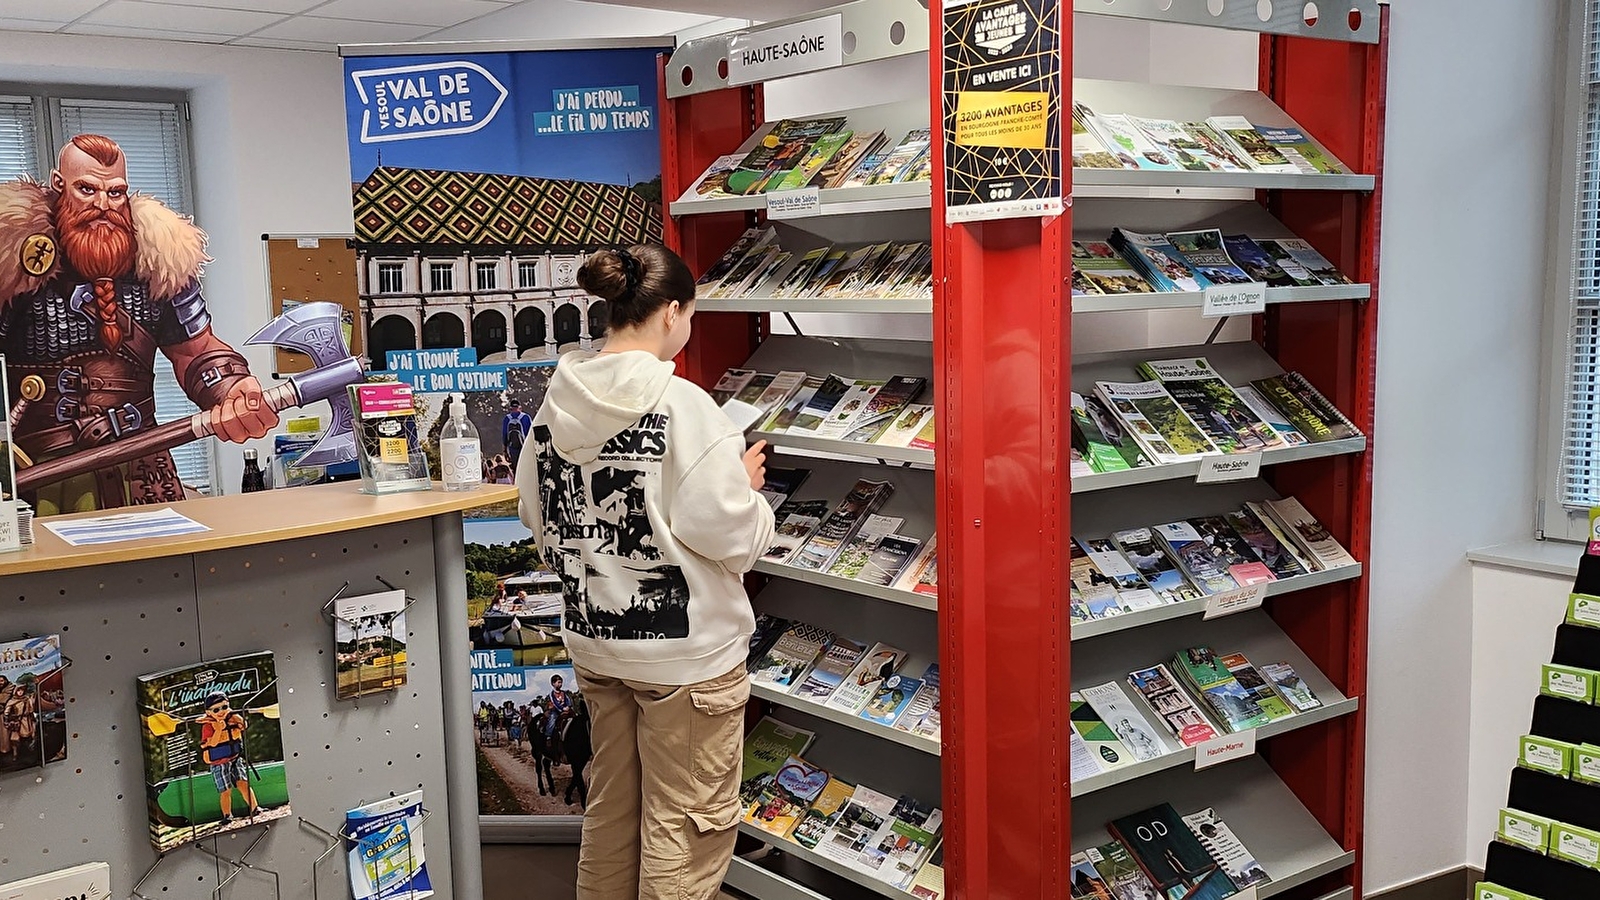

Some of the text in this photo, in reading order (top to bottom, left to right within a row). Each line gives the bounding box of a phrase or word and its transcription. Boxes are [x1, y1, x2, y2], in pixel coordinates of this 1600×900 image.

[982, 3, 1018, 21] LA CARTE
[974, 11, 1027, 34] AVANTAGES
[742, 34, 825, 67] HAUTE-SAÔNE
[972, 64, 1032, 86] EN VENTE ICI
[387, 72, 470, 101] VAL DE
[375, 81, 390, 129] VESOUL
[394, 99, 474, 129] SAÔNE
[960, 100, 1043, 122] 3200 AVANTAGES
[589, 112, 608, 131] DU
[610, 109, 650, 130] TEMPS
[968, 119, 1000, 130] BOURGOGNE
[975, 130, 988, 138] TOUS
[988, 128, 998, 136] LES
[801, 194, 818, 203] Saône
[1210, 293, 1229, 303] Vallée
[1229, 293, 1238, 302] de
[416, 348, 475, 369] TROUVÉ...
[1157, 367, 1213, 378] Haute-Saône
[430, 373, 454, 391] BON
[1103, 384, 1115, 395] 3
[638, 413, 669, 430] THE
[601, 429, 666, 456] SSICS
[1211, 459, 1250, 470] Haute-Saône
[0, 647, 45, 665] ÉRIC
[168, 672, 252, 708] L'inattendu
[472, 673, 522, 690] ATTENDU
[1206, 741, 1244, 757] Haute-Marne
